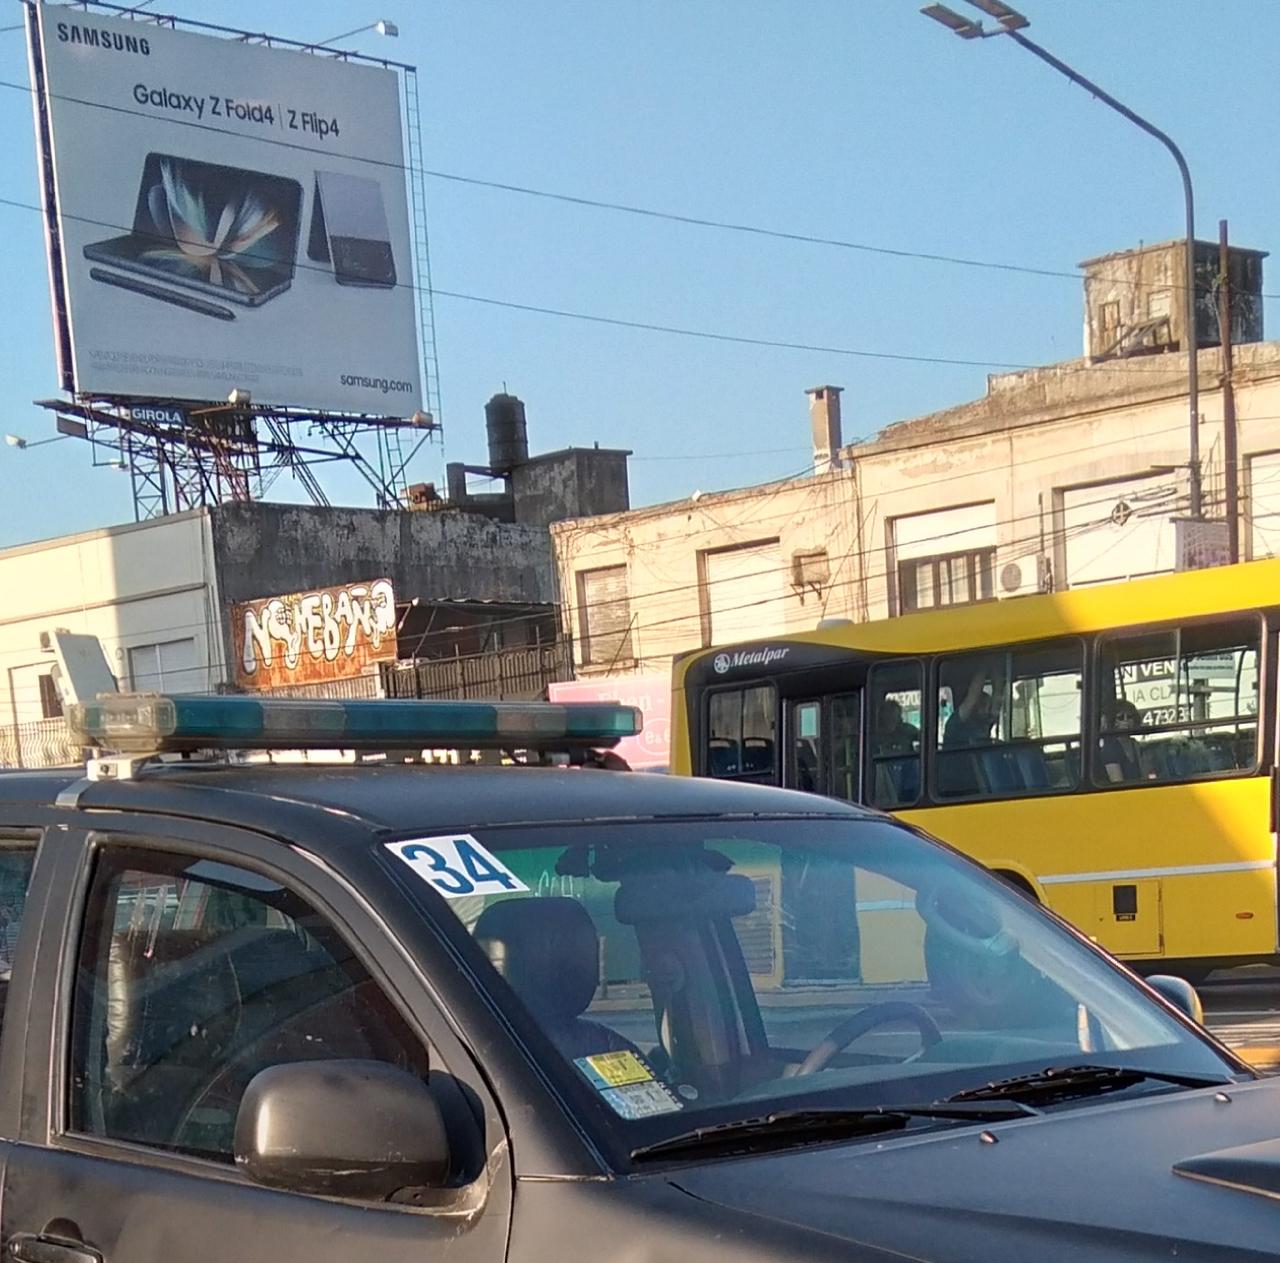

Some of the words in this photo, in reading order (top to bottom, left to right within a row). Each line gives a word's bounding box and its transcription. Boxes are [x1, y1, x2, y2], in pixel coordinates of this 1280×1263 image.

[57, 23, 150, 56] SAMSUNG
[133, 83, 206, 119] Galaxy
[210, 95, 222, 116] Z
[225, 98, 275, 125] Fold4
[286, 109, 298, 129] Z
[301, 112, 340, 140] Flip4
[340, 372, 413, 394] samsung.com
[131, 407, 183, 424] GIROLA
[730, 647, 790, 667] Metalpar
[1140, 660, 1176, 676] VEN
[400, 839, 518, 895] 34
